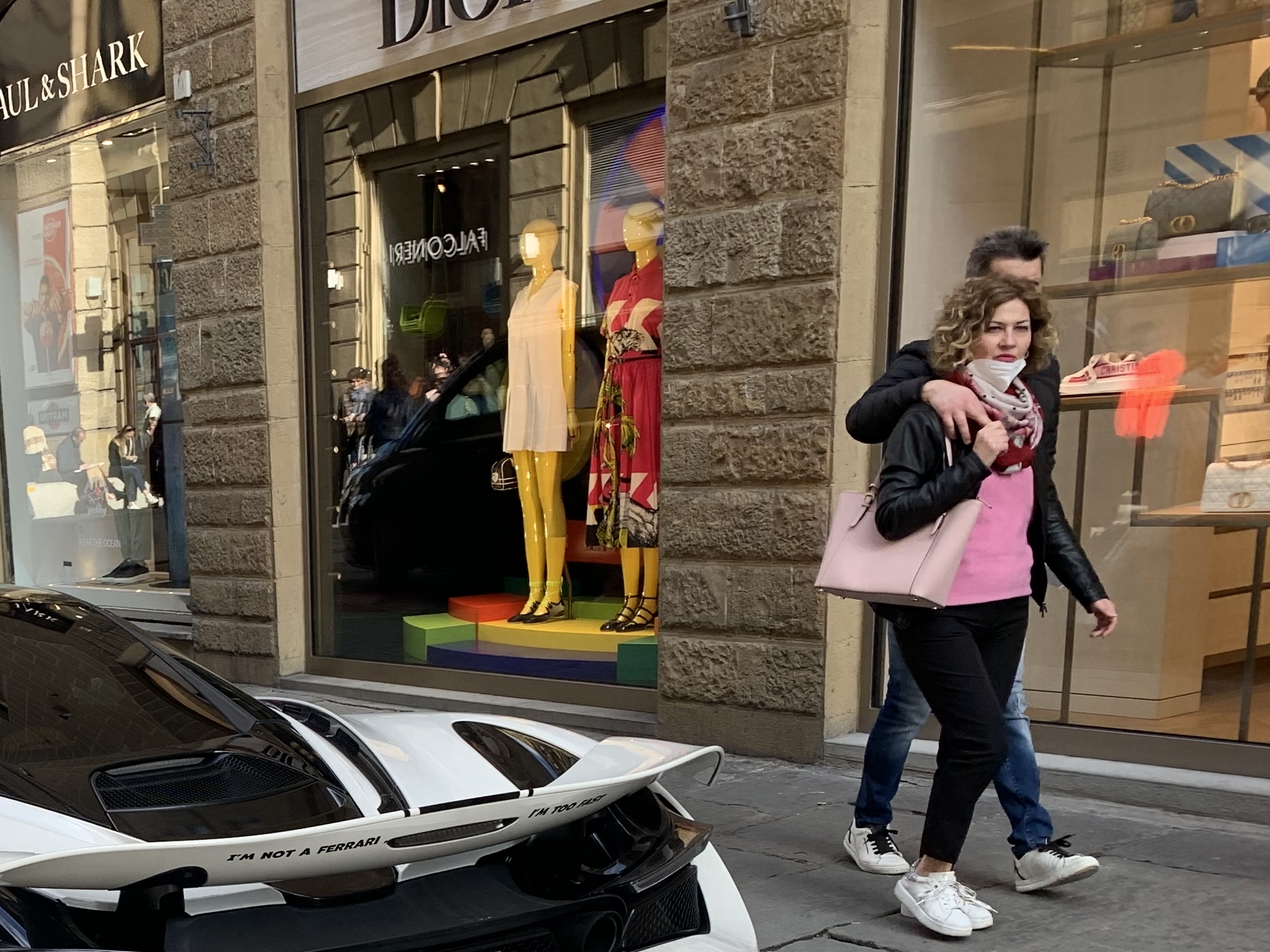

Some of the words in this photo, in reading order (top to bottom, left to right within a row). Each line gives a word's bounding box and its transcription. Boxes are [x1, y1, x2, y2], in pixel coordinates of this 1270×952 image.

[57, 30, 148, 99] SHARK
[528, 807, 550, 818] I'M
[551, 802, 578, 814] TOO
[577, 794, 607, 808] FAST
[227, 853, 255, 861] I'M
[260, 849, 296, 860] NOT
[299, 848, 311, 857] A
